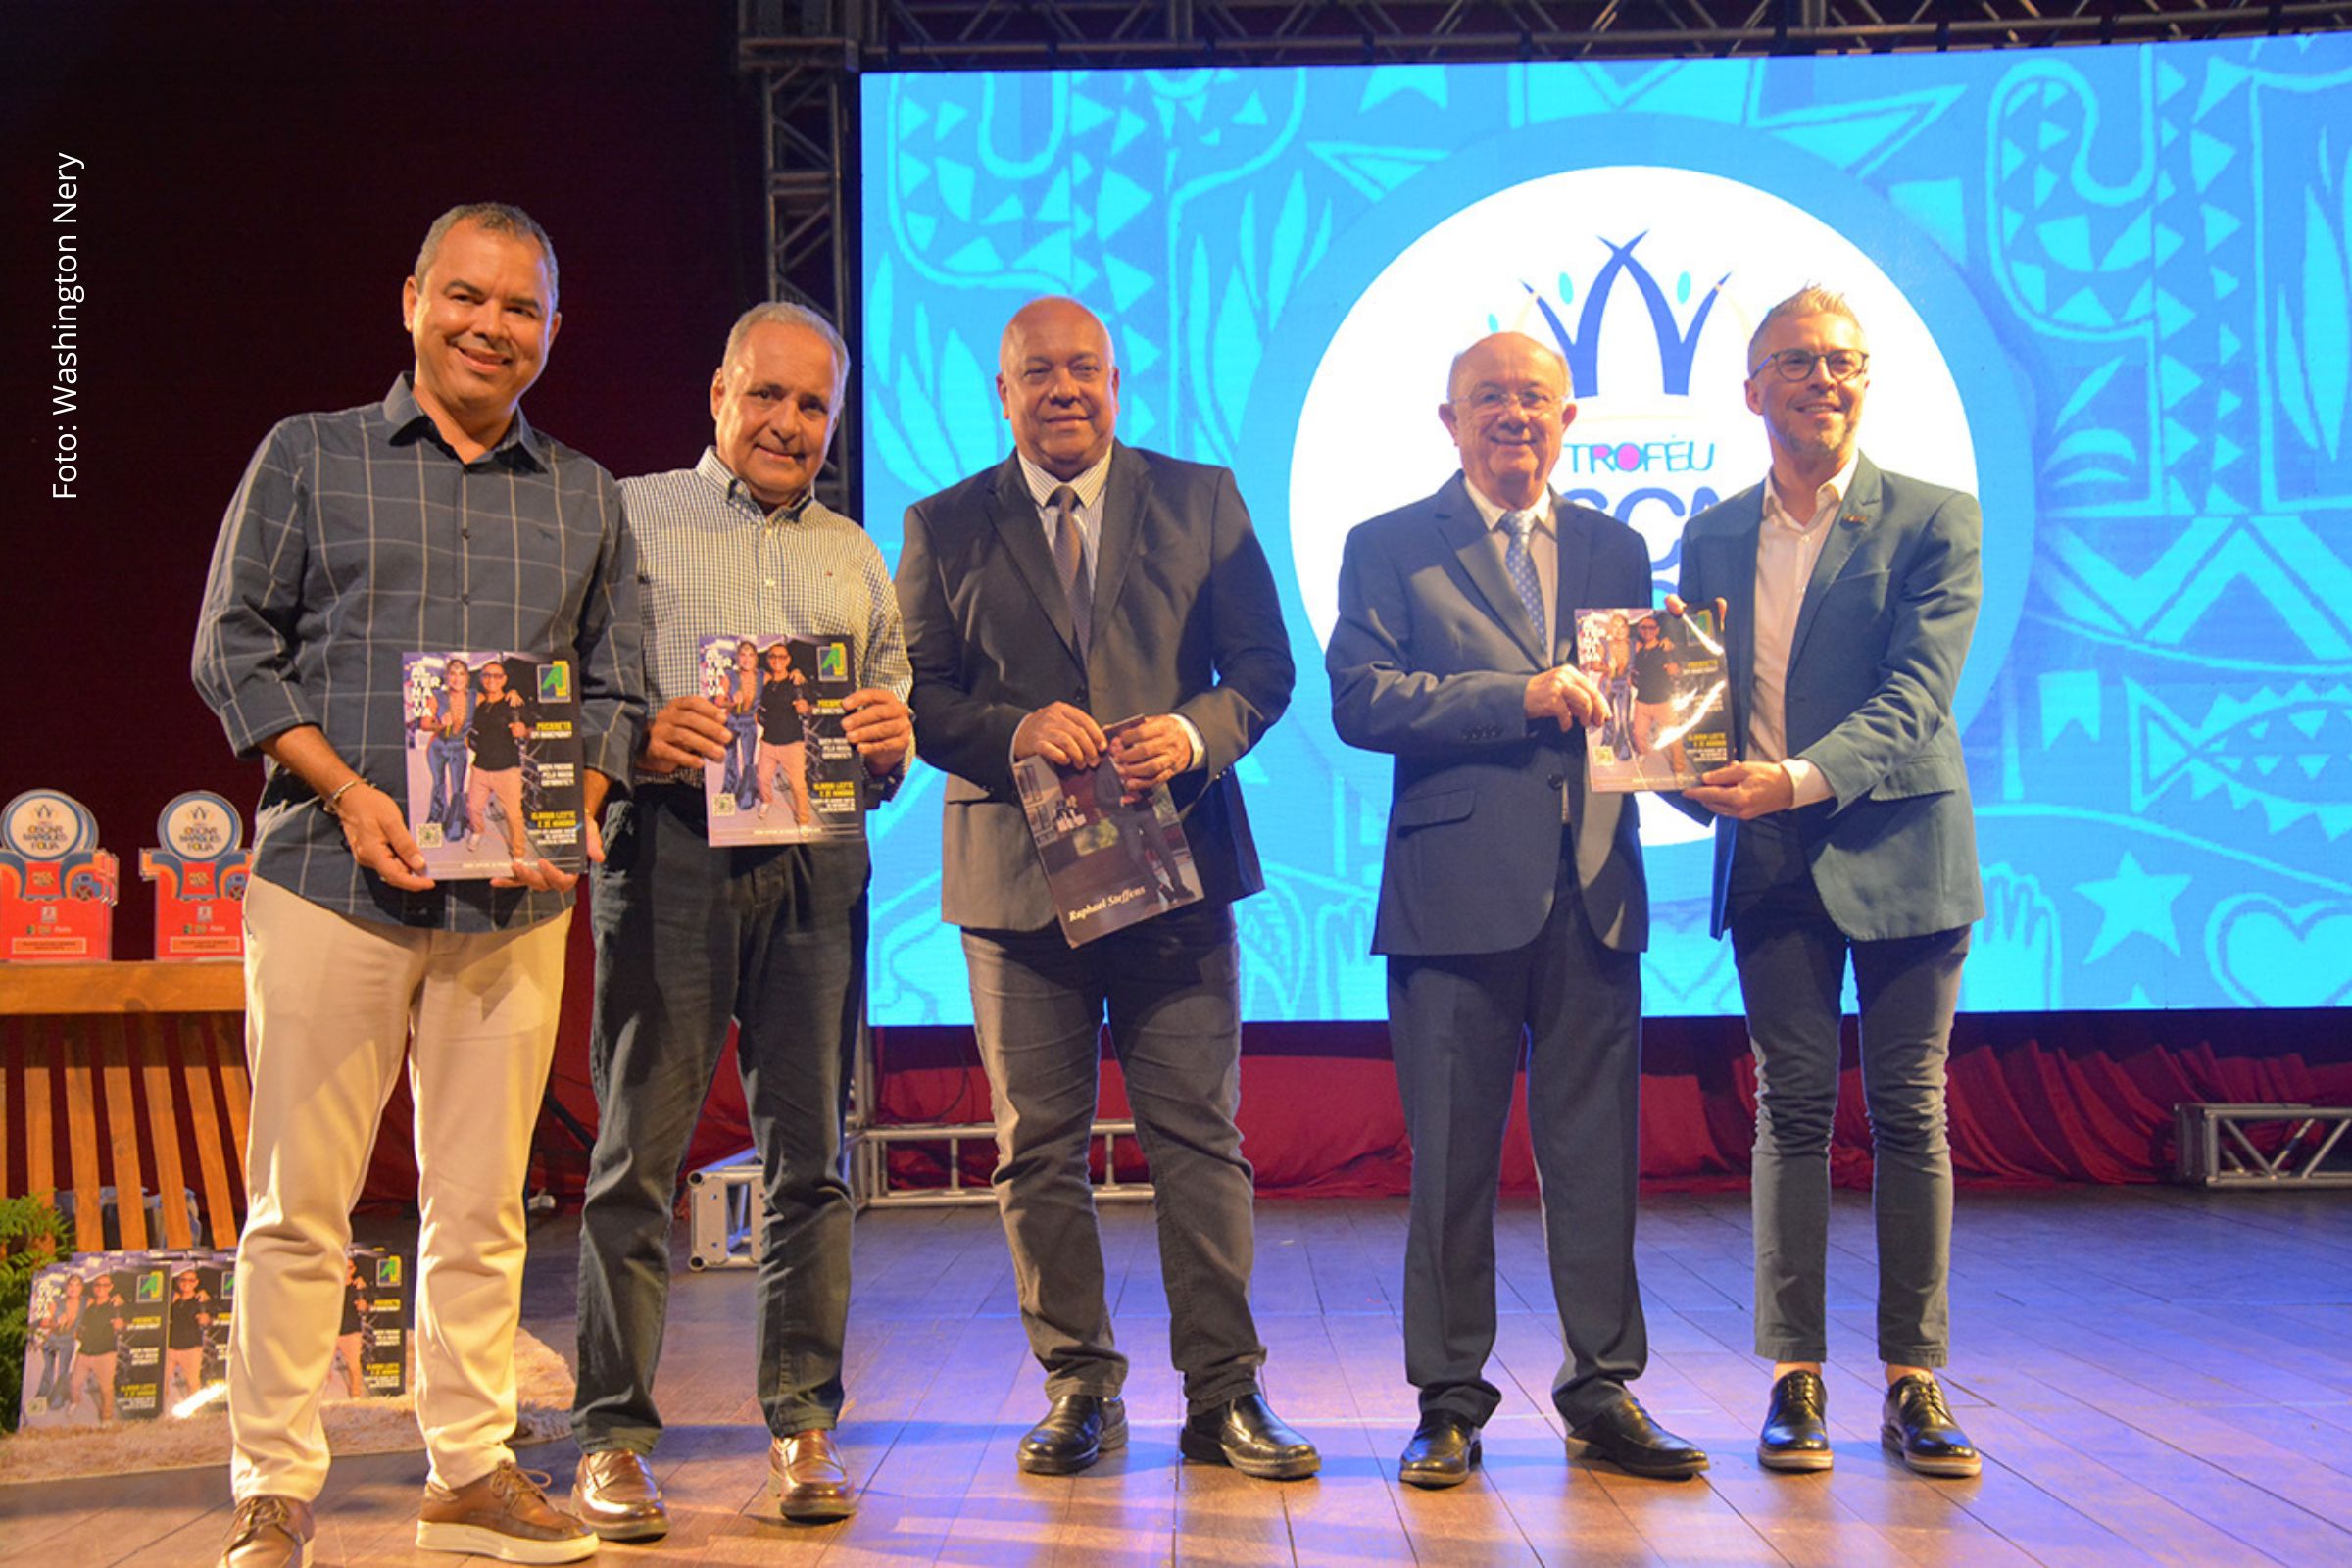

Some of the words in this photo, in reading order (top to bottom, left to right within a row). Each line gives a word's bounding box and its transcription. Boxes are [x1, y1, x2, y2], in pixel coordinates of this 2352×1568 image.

[1563, 434, 1715, 474] TROFÉU
[1069, 899, 1107, 922] Raphael
[1107, 886, 1146, 906] Steffens
